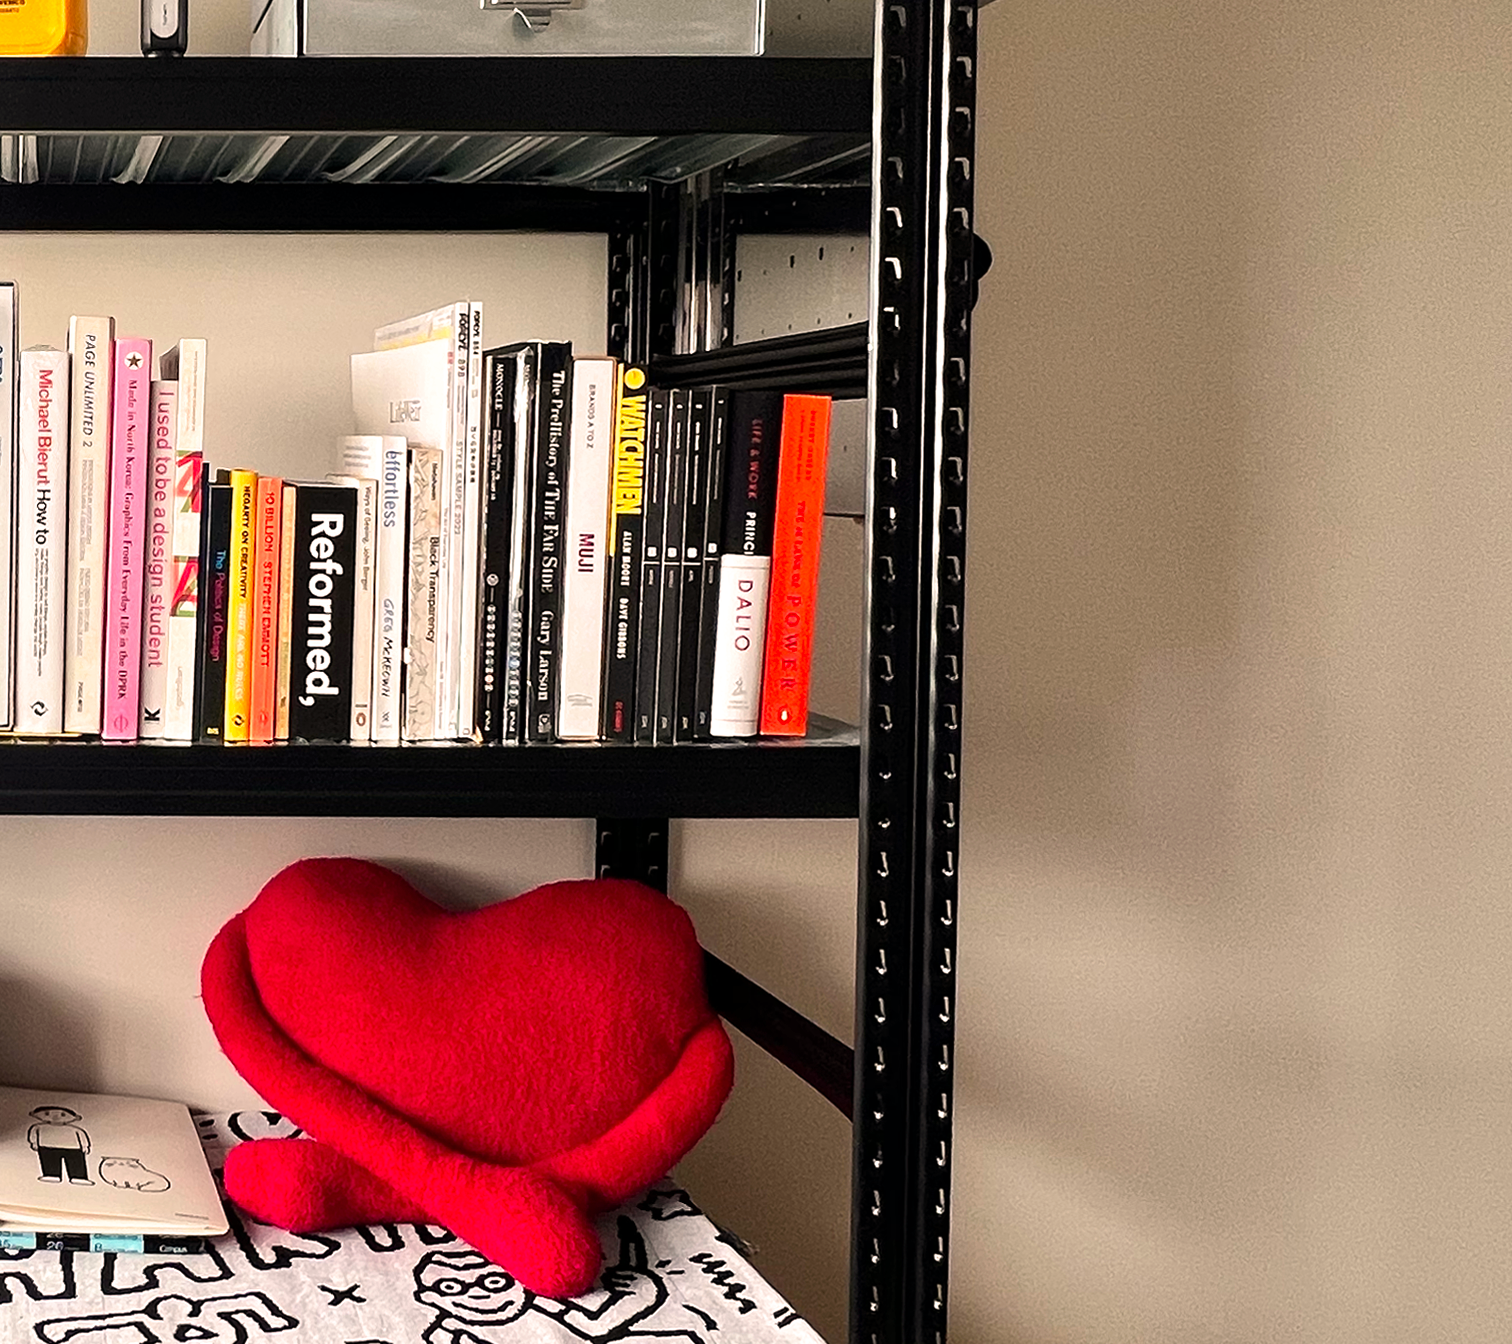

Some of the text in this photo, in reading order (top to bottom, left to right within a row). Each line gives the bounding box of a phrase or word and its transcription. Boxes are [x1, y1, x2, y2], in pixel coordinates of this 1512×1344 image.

[85, 334, 96, 367] PAGE
[38, 369, 54, 432] Michael
[82, 371, 95, 435] UNLIMITED
[494, 363, 505, 411] MONOCLE
[551, 370, 565, 395] The
[156, 402, 173, 449] used
[751, 419, 763, 444] LIFE
[36, 436, 52, 485] Bierut
[156, 457, 171, 473] to
[455, 441, 463, 469] STYLE
[548, 471, 559, 484] of
[616, 395, 646, 515] WATCHMEN
[155, 478, 170, 501] be
[265, 492, 275, 505] 10
[384, 450, 401, 527] effortless
[454, 472, 462, 510] SAMPLE
[747, 461, 760, 500] WORK
[35, 488, 51, 523] How
[154, 507, 165, 517] a
[35, 529, 49, 545] to
[116, 379, 138, 700] Made in North Korea: Graphics From Everyday Life in the DPRK
[263, 508, 274, 552] BILLION
[543, 523, 559, 552] FAR
[578, 533, 595, 573] MUJI
[148, 522, 168, 587] design
[619, 531, 633, 586] ALAN MOORE
[261, 562, 273, 614] STEPHEN
[361, 566, 369, 591] Berger
[426, 536, 440, 643] Black Transparency
[210, 550, 227, 662] The Politics of Design
[298, 513, 345, 706] Reformed,
[616, 597, 629, 659] DAVE GIBBONS
[734, 580, 753, 652] DALIO
[147, 594, 165, 667] student
[381, 598, 395, 697] GREG McKEOWN
[536, 610, 554, 701] Gary Larson
